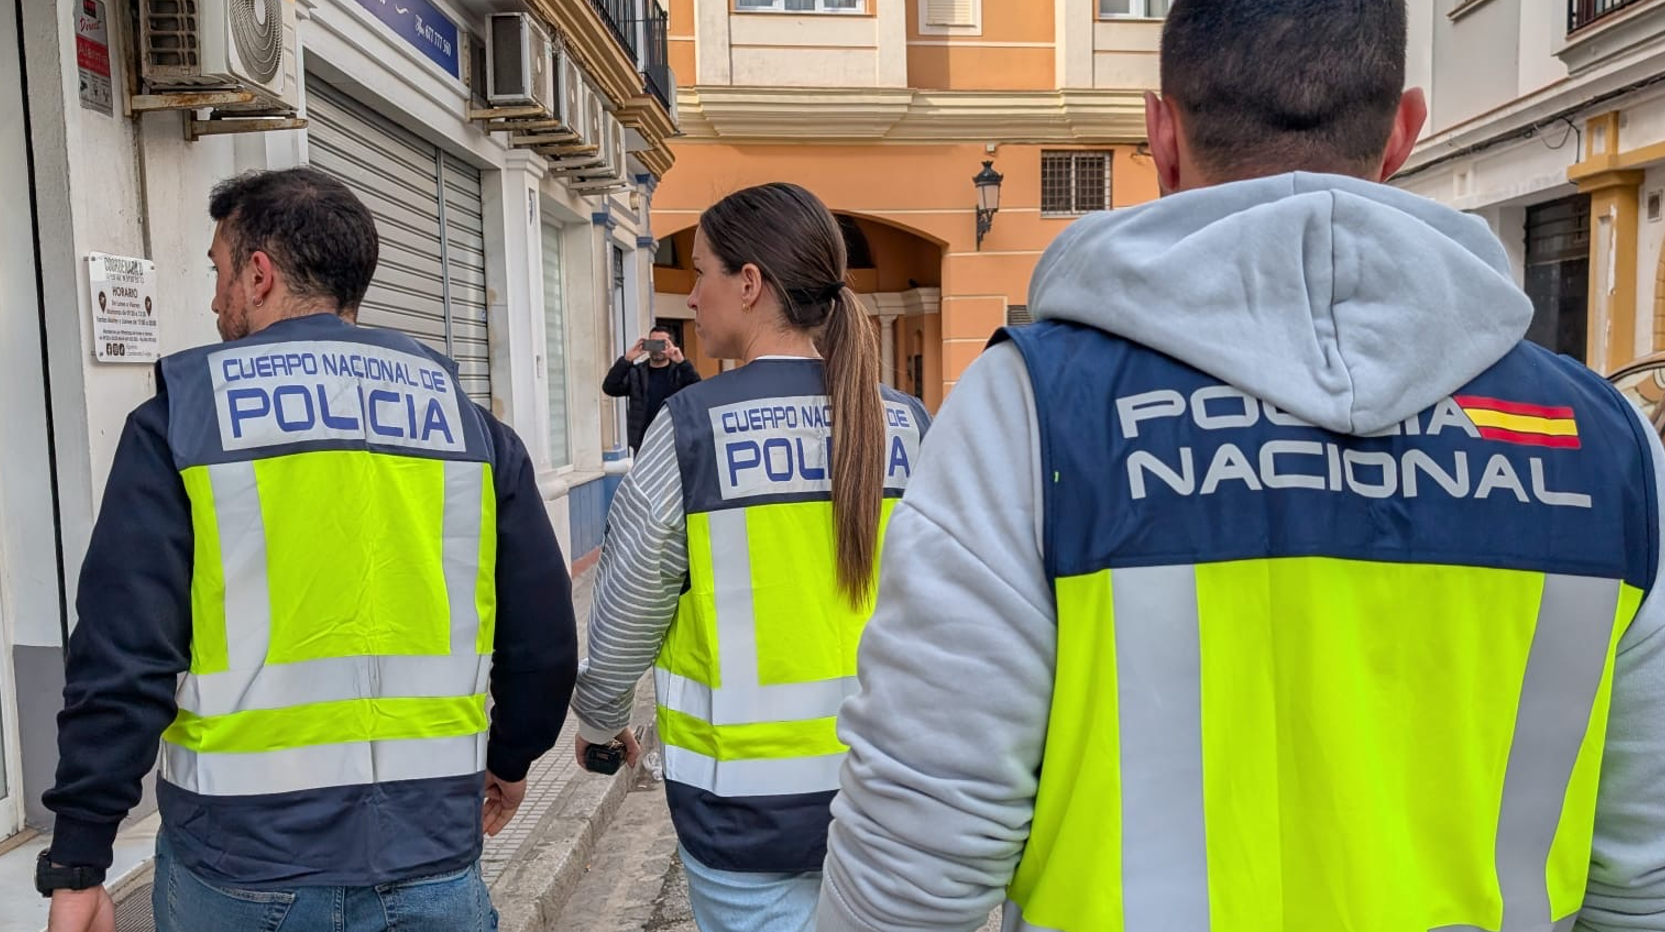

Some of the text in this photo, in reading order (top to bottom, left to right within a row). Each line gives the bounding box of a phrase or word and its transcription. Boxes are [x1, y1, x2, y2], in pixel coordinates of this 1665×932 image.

[112, 286, 138, 298] HORARIO
[223, 353, 447, 393] CUERPO NACIONAL DE
[226, 384, 454, 444] POLICIA
[722, 405, 797, 433] CUERPO
[885, 408, 910, 428] DE
[726, 435, 911, 487] POLIA
[1126, 440, 1592, 508] NACIONAL
